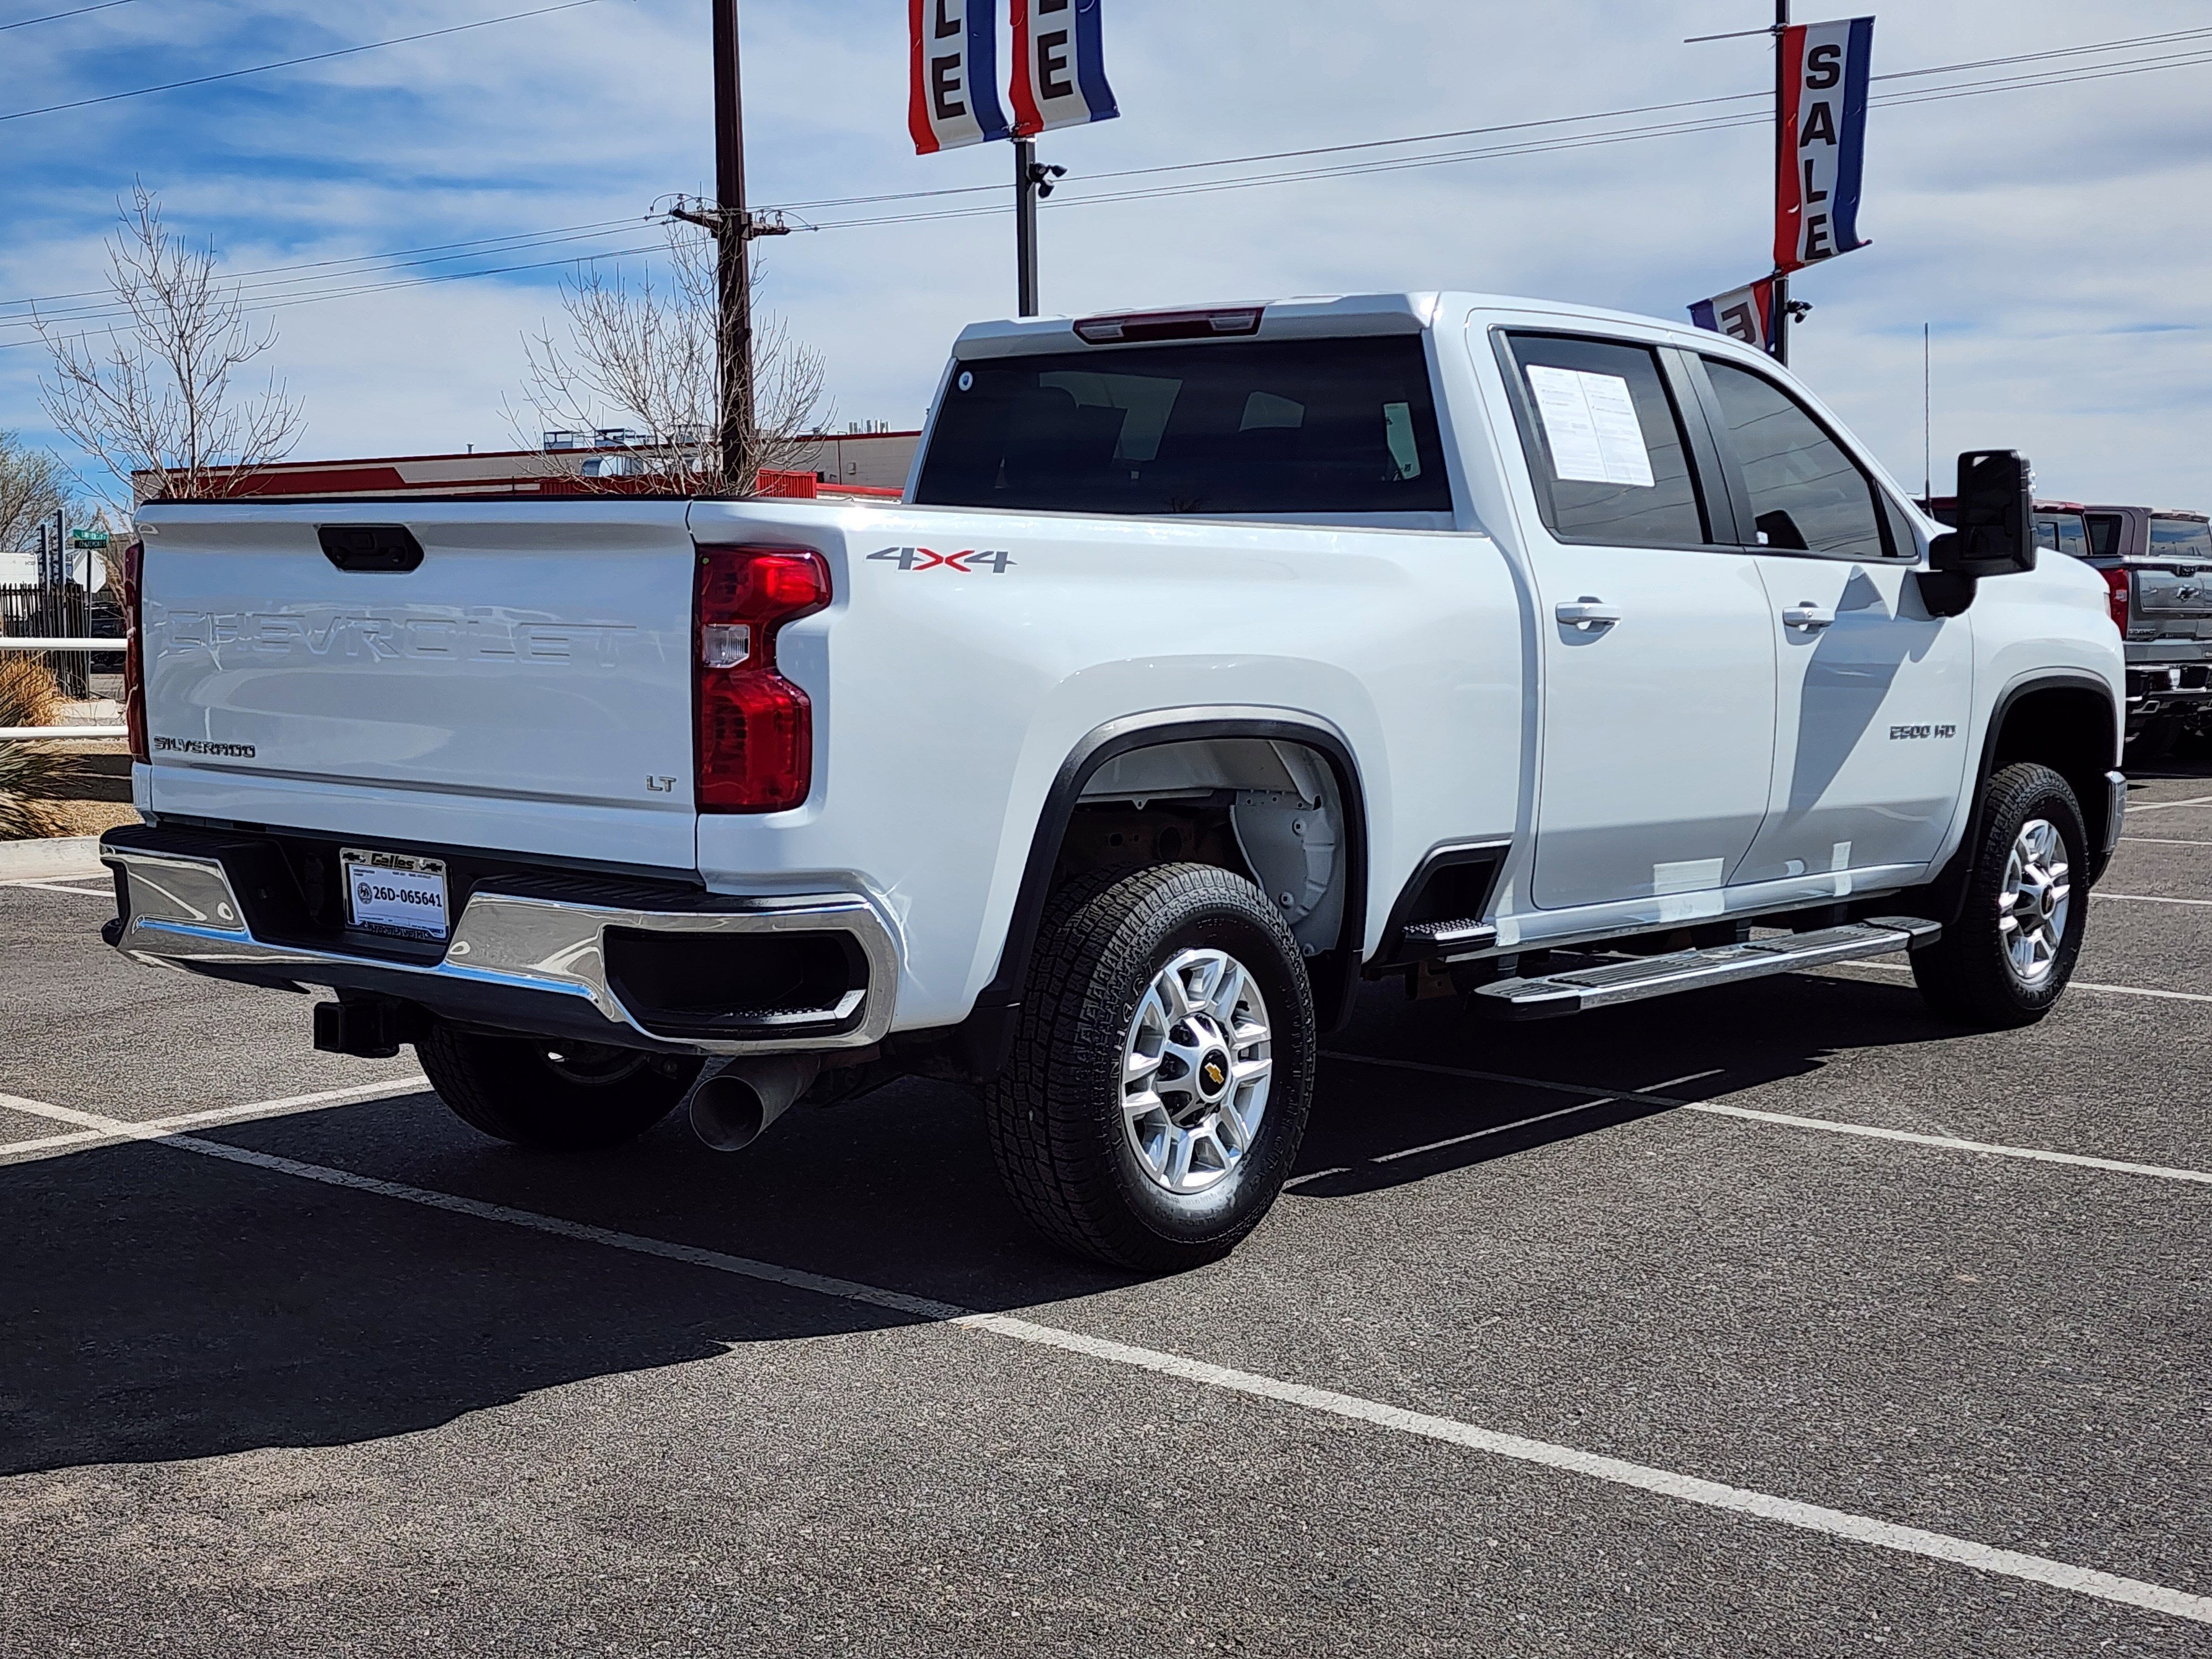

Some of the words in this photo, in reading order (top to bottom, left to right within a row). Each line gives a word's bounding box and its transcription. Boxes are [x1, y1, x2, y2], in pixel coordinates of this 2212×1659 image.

[1799, 44, 1841, 261] SALE
[167, 611, 638, 667] CHEVROLET
[154, 735, 255, 758] SILVERADO
[646, 775, 677, 792] LT
[371, 853, 415, 869] Galles
[373, 886, 443, 907] 26D-065641
